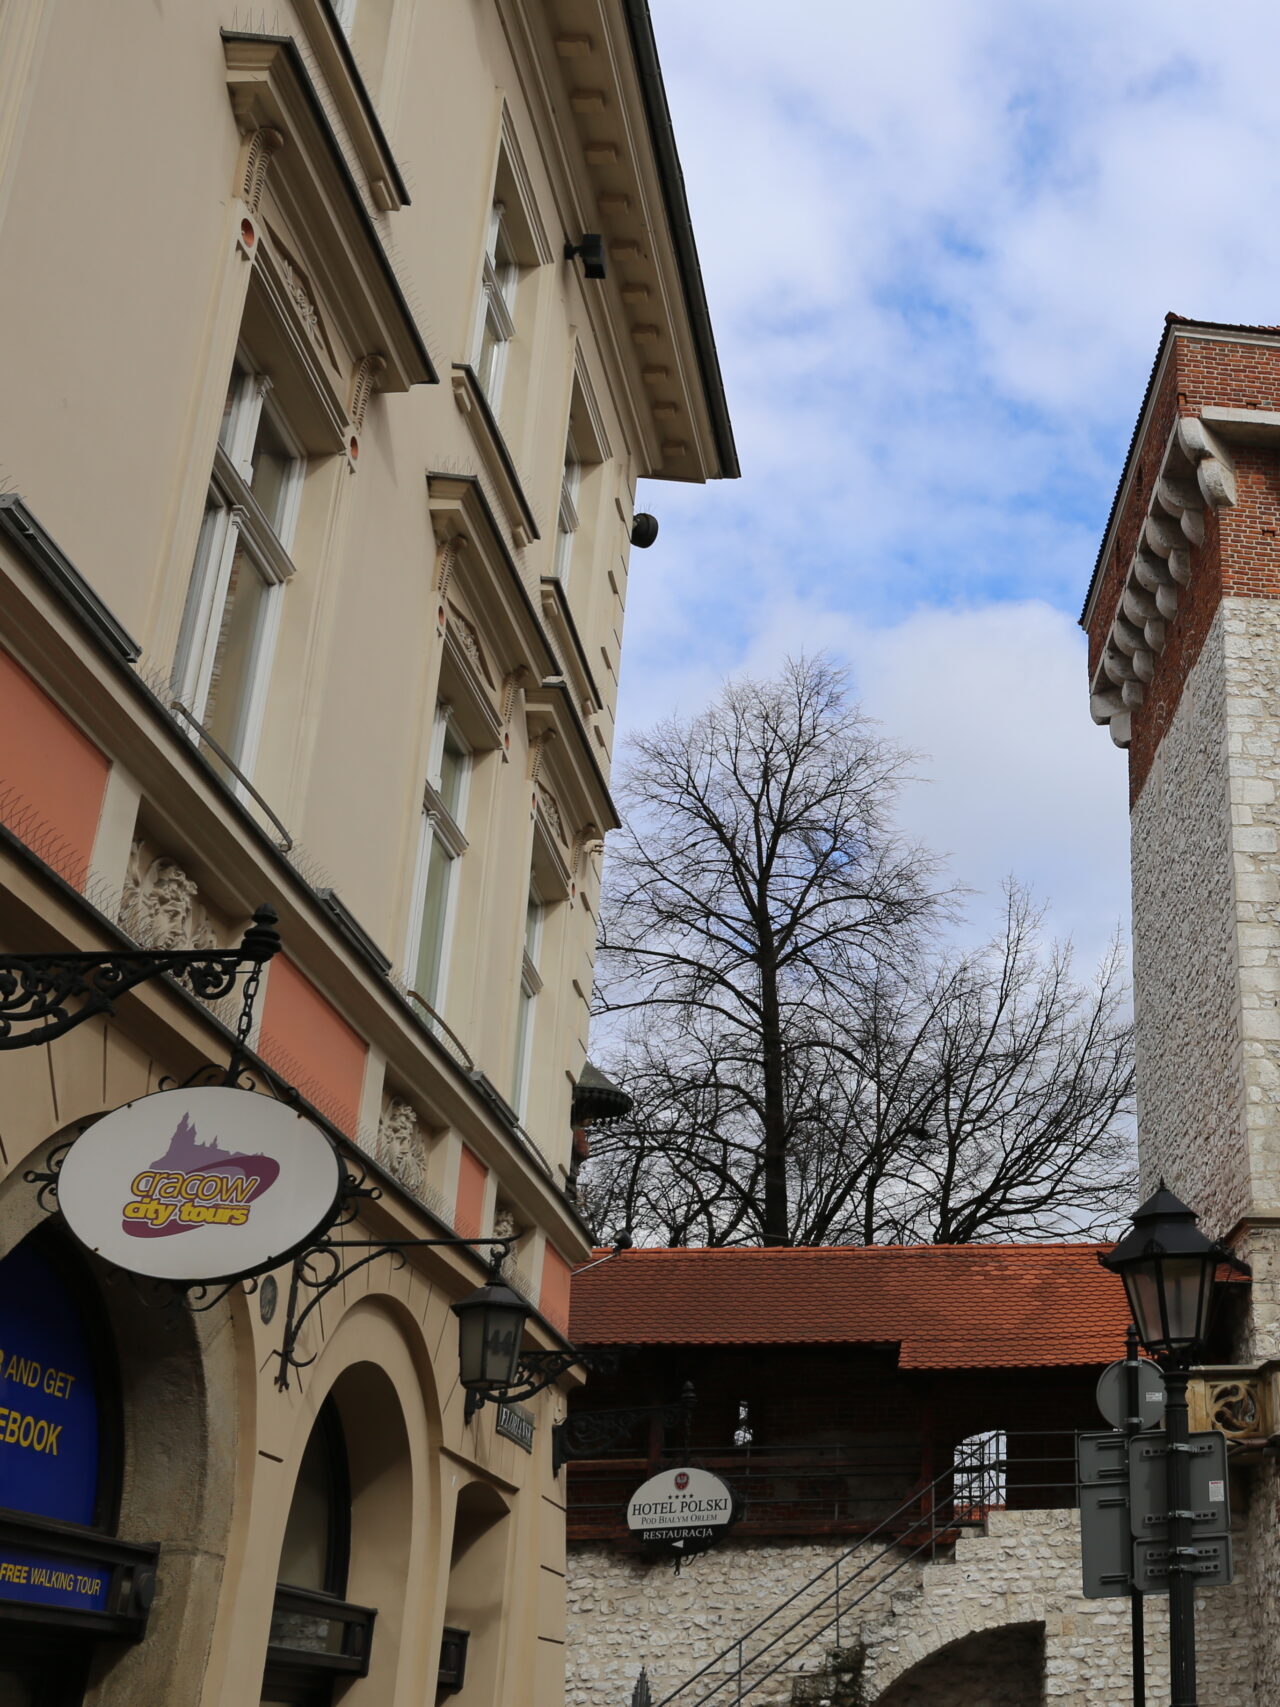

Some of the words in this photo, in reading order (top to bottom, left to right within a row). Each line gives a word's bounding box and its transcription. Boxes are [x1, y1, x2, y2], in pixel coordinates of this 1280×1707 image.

[130, 1170, 259, 1203] cracow
[122, 1197, 177, 1226] city
[178, 1200, 250, 1225] tours
[4, 1354, 41, 1388] AND
[43, 1367, 76, 1400] GET
[632, 1502, 677, 1516] HOTEL
[680, 1498, 728, 1513] POLSKI
[643, 1528, 713, 1540] RESTAURACJA
[0, 1563, 29, 1585] FREE
[30, 1567, 75, 1591] WALKING
[75, 1575, 101, 1596] TOUR
